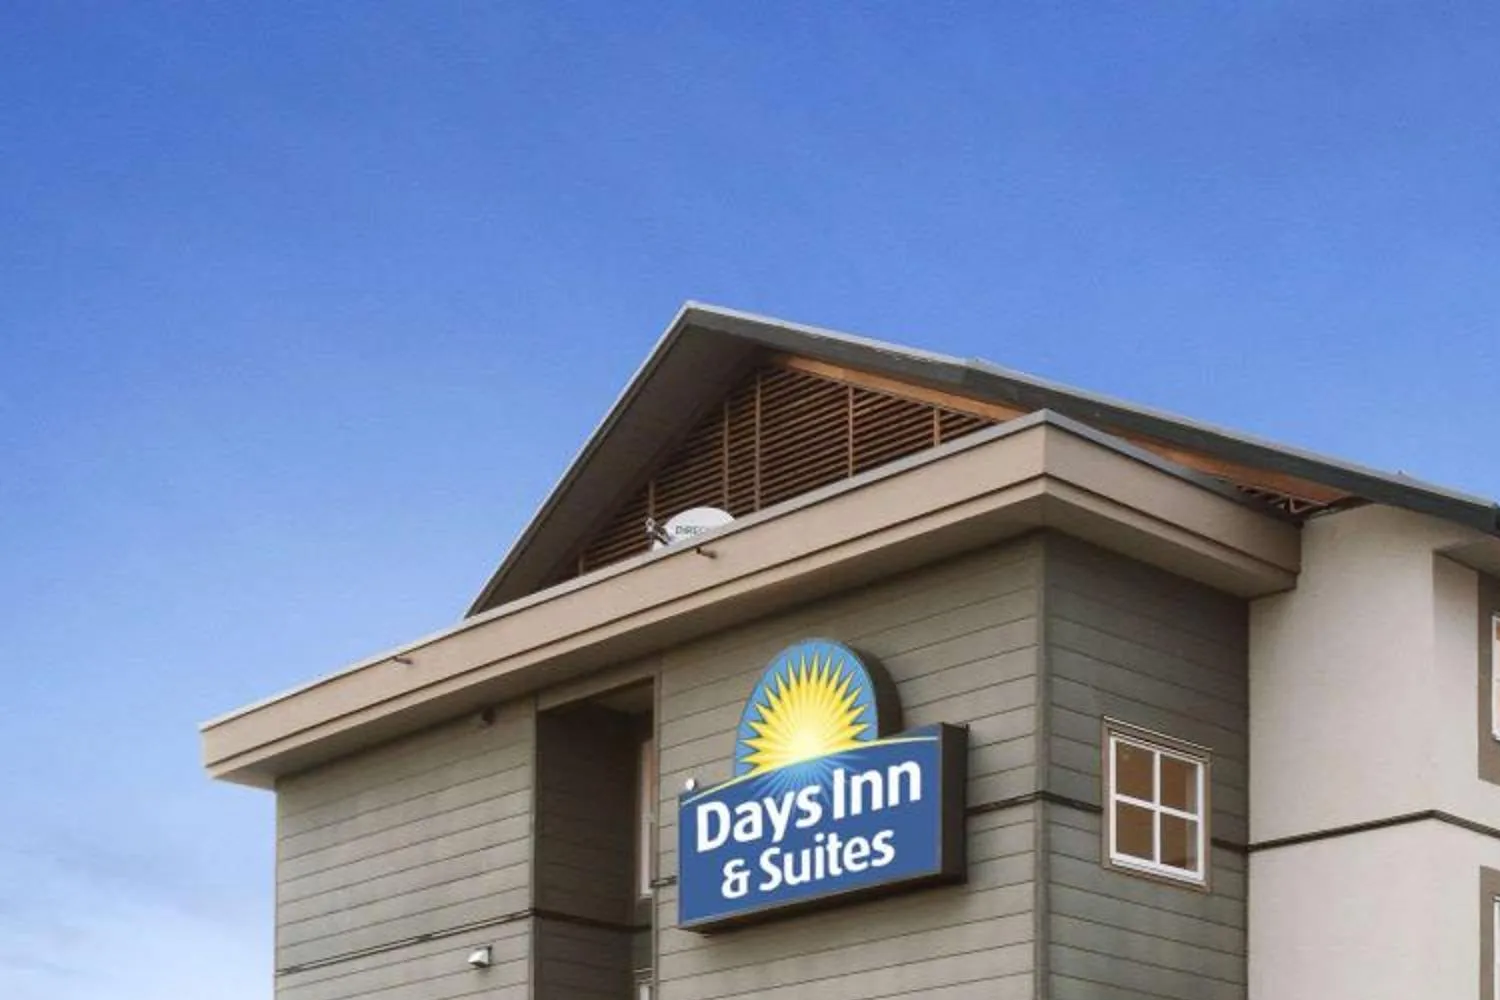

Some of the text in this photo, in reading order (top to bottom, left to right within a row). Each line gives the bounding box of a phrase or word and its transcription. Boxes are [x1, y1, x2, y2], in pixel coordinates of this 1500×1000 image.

[696, 760, 921, 853] Days Inn
[721, 829, 895, 899] & Suites
